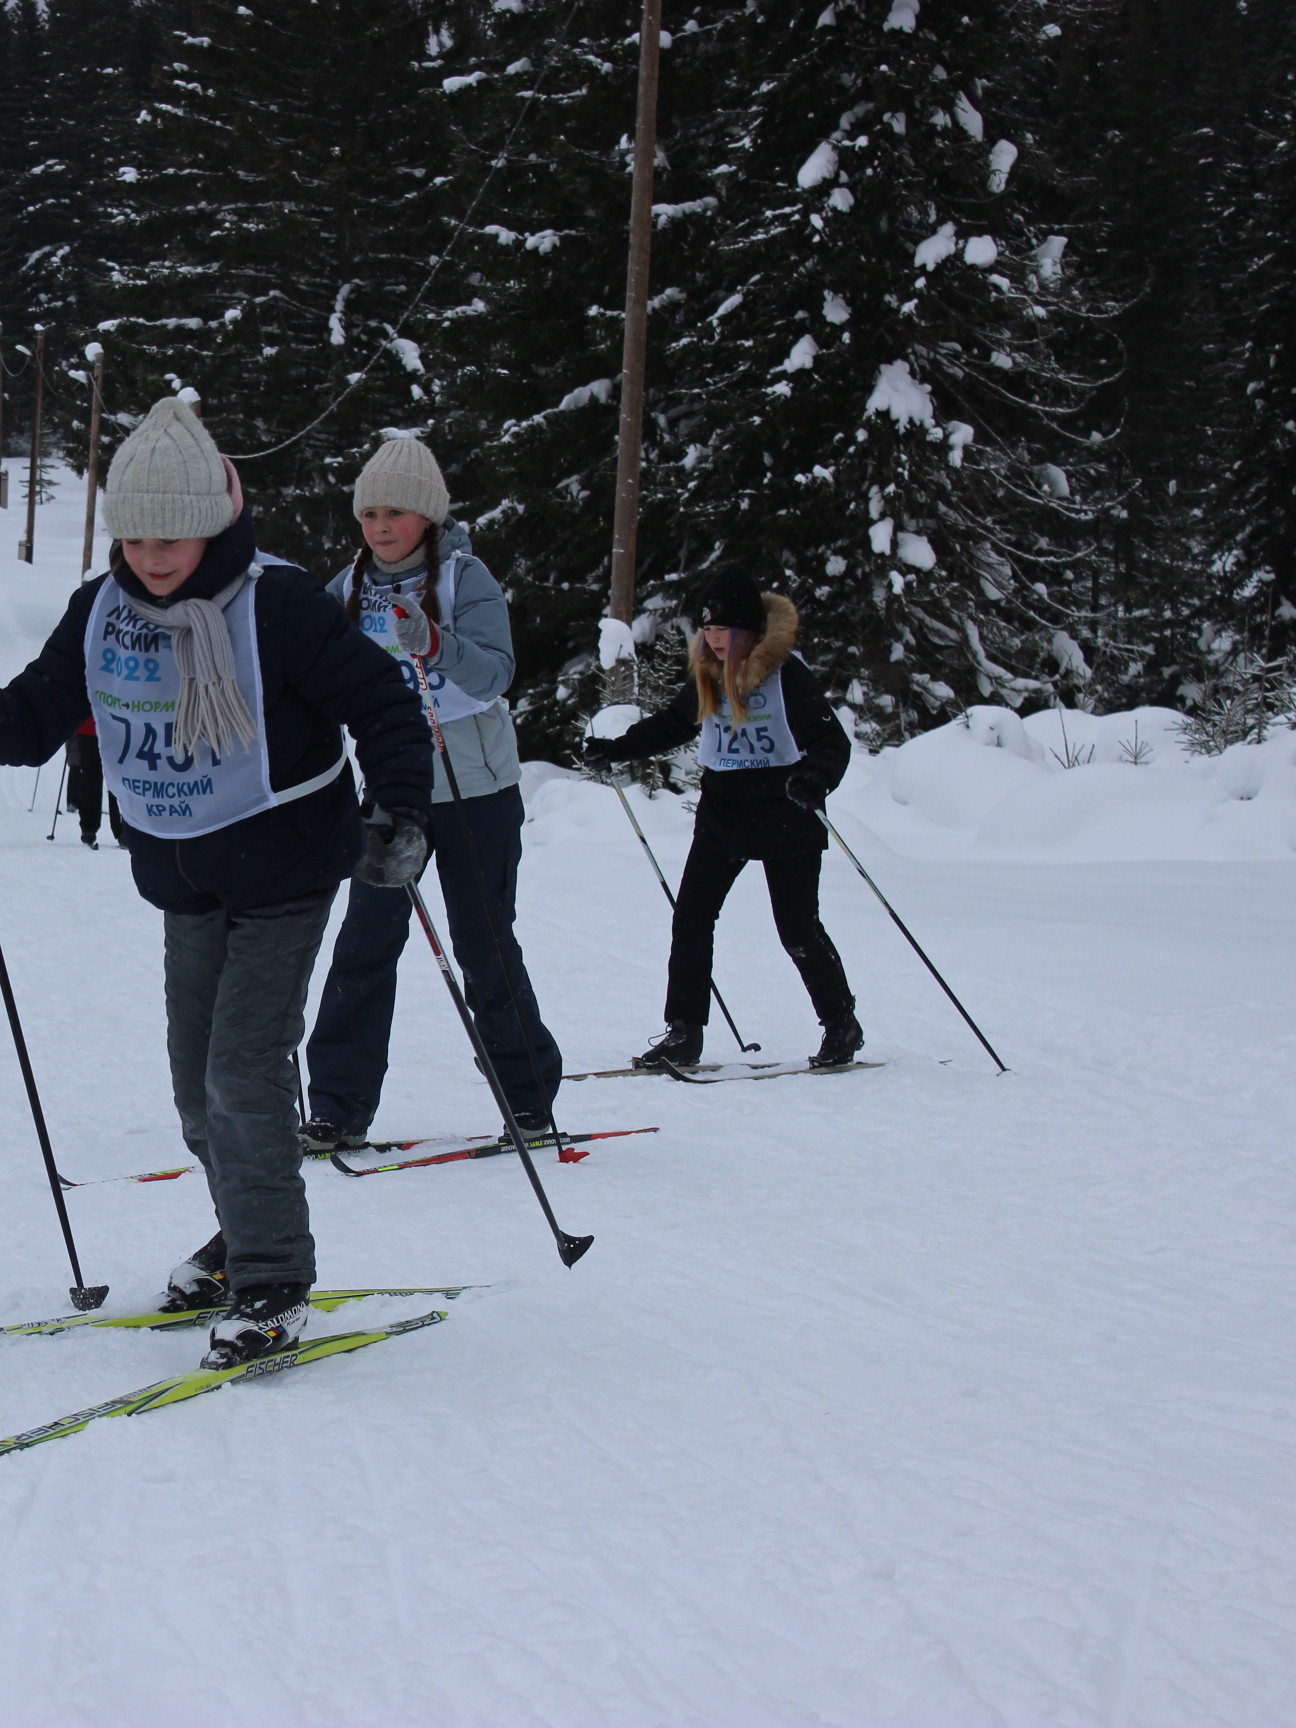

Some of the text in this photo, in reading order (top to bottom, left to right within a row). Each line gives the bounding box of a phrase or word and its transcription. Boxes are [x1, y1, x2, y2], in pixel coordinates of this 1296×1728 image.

[131, 700, 178, 713] НОРМ
[715, 723, 776, 755] 1215
[719, 757, 770, 768] ПЕРМСКИЙ
[121, 773, 214, 800] ПЕРМСКИЙ
[145, 800, 193, 818] КРАЙ
[258, 1300, 309, 1332] SALOMON
[245, 1351, 299, 1379] FISCHER
